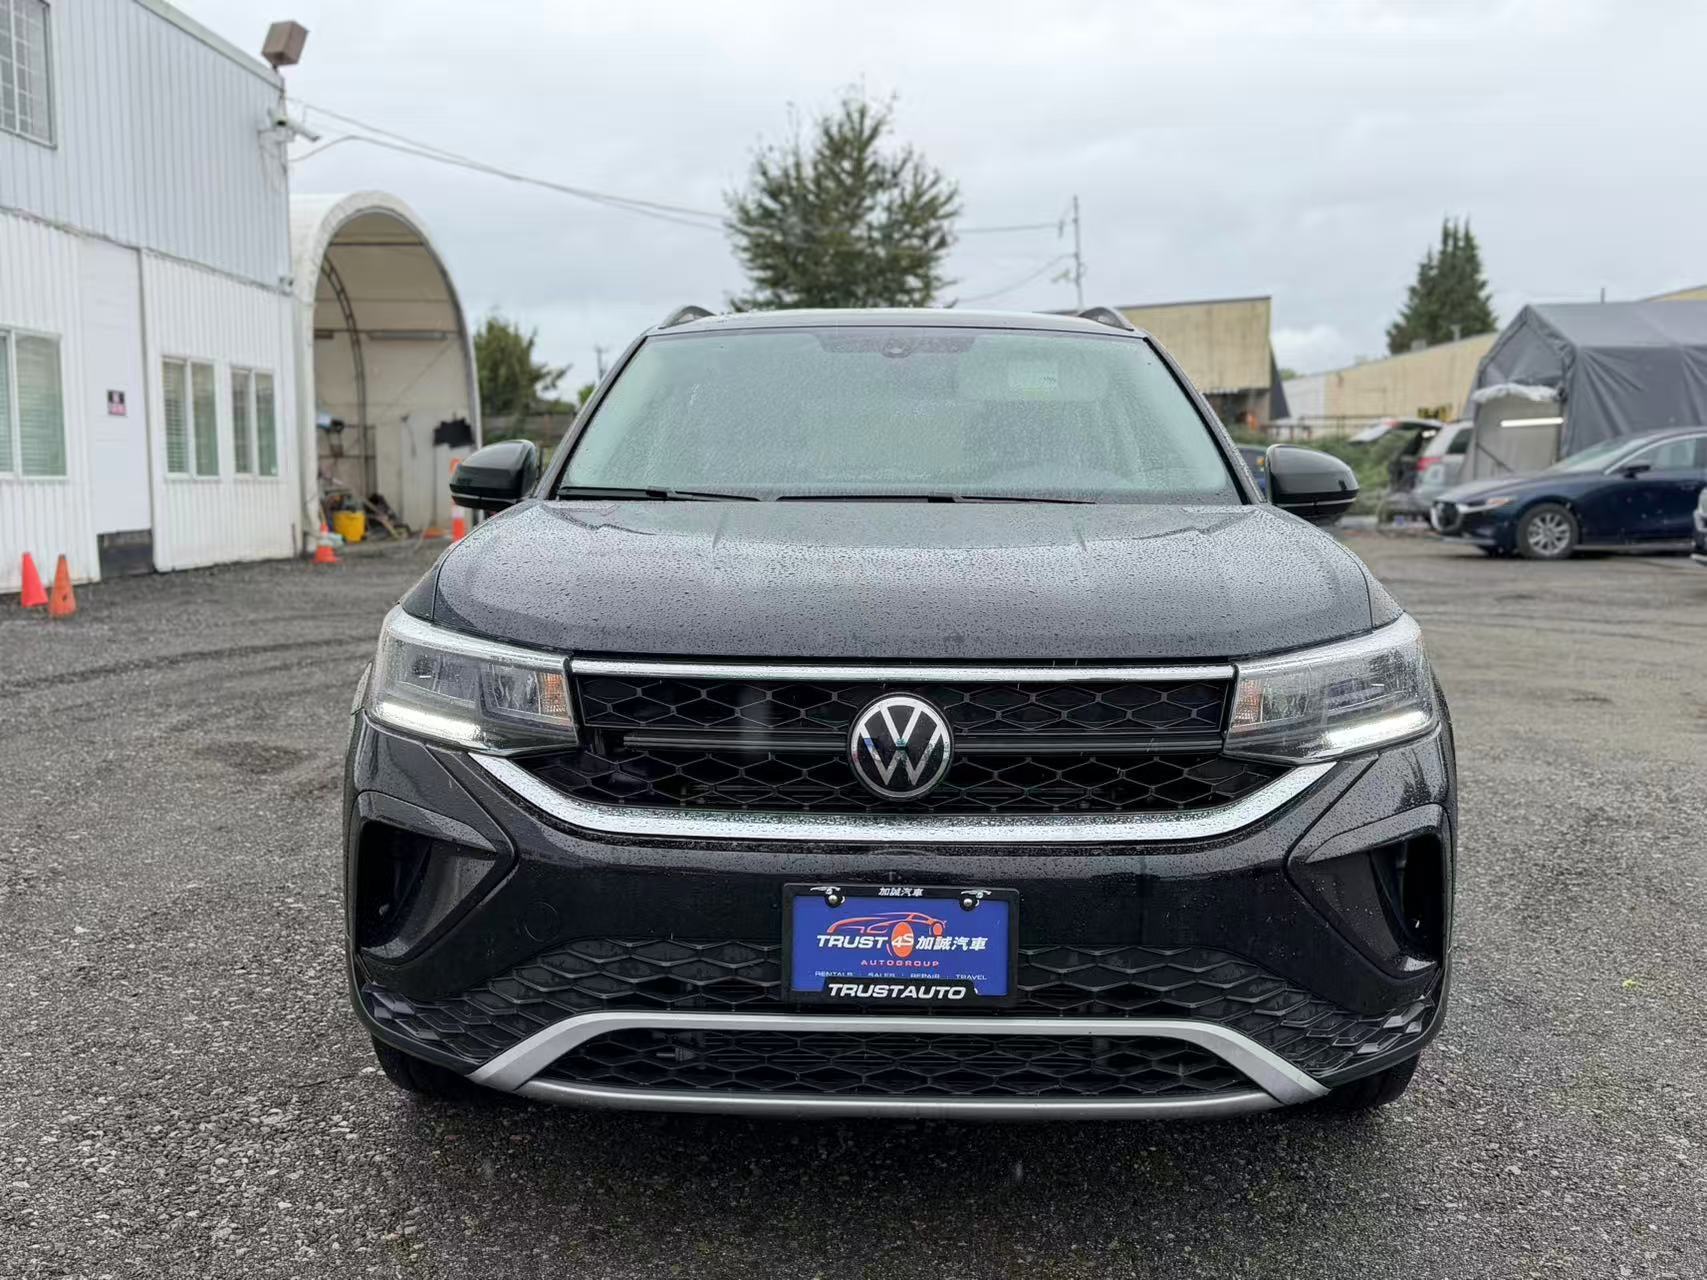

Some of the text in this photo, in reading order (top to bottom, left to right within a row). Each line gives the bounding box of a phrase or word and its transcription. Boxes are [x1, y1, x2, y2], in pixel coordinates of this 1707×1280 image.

[857, 698, 944, 787] VW
[816, 933, 988, 951] TRUST 4S 加誠汽車
[860, 959, 939, 967] AUTOGROUP
[828, 983, 966, 1000] TRUSTAUTO
